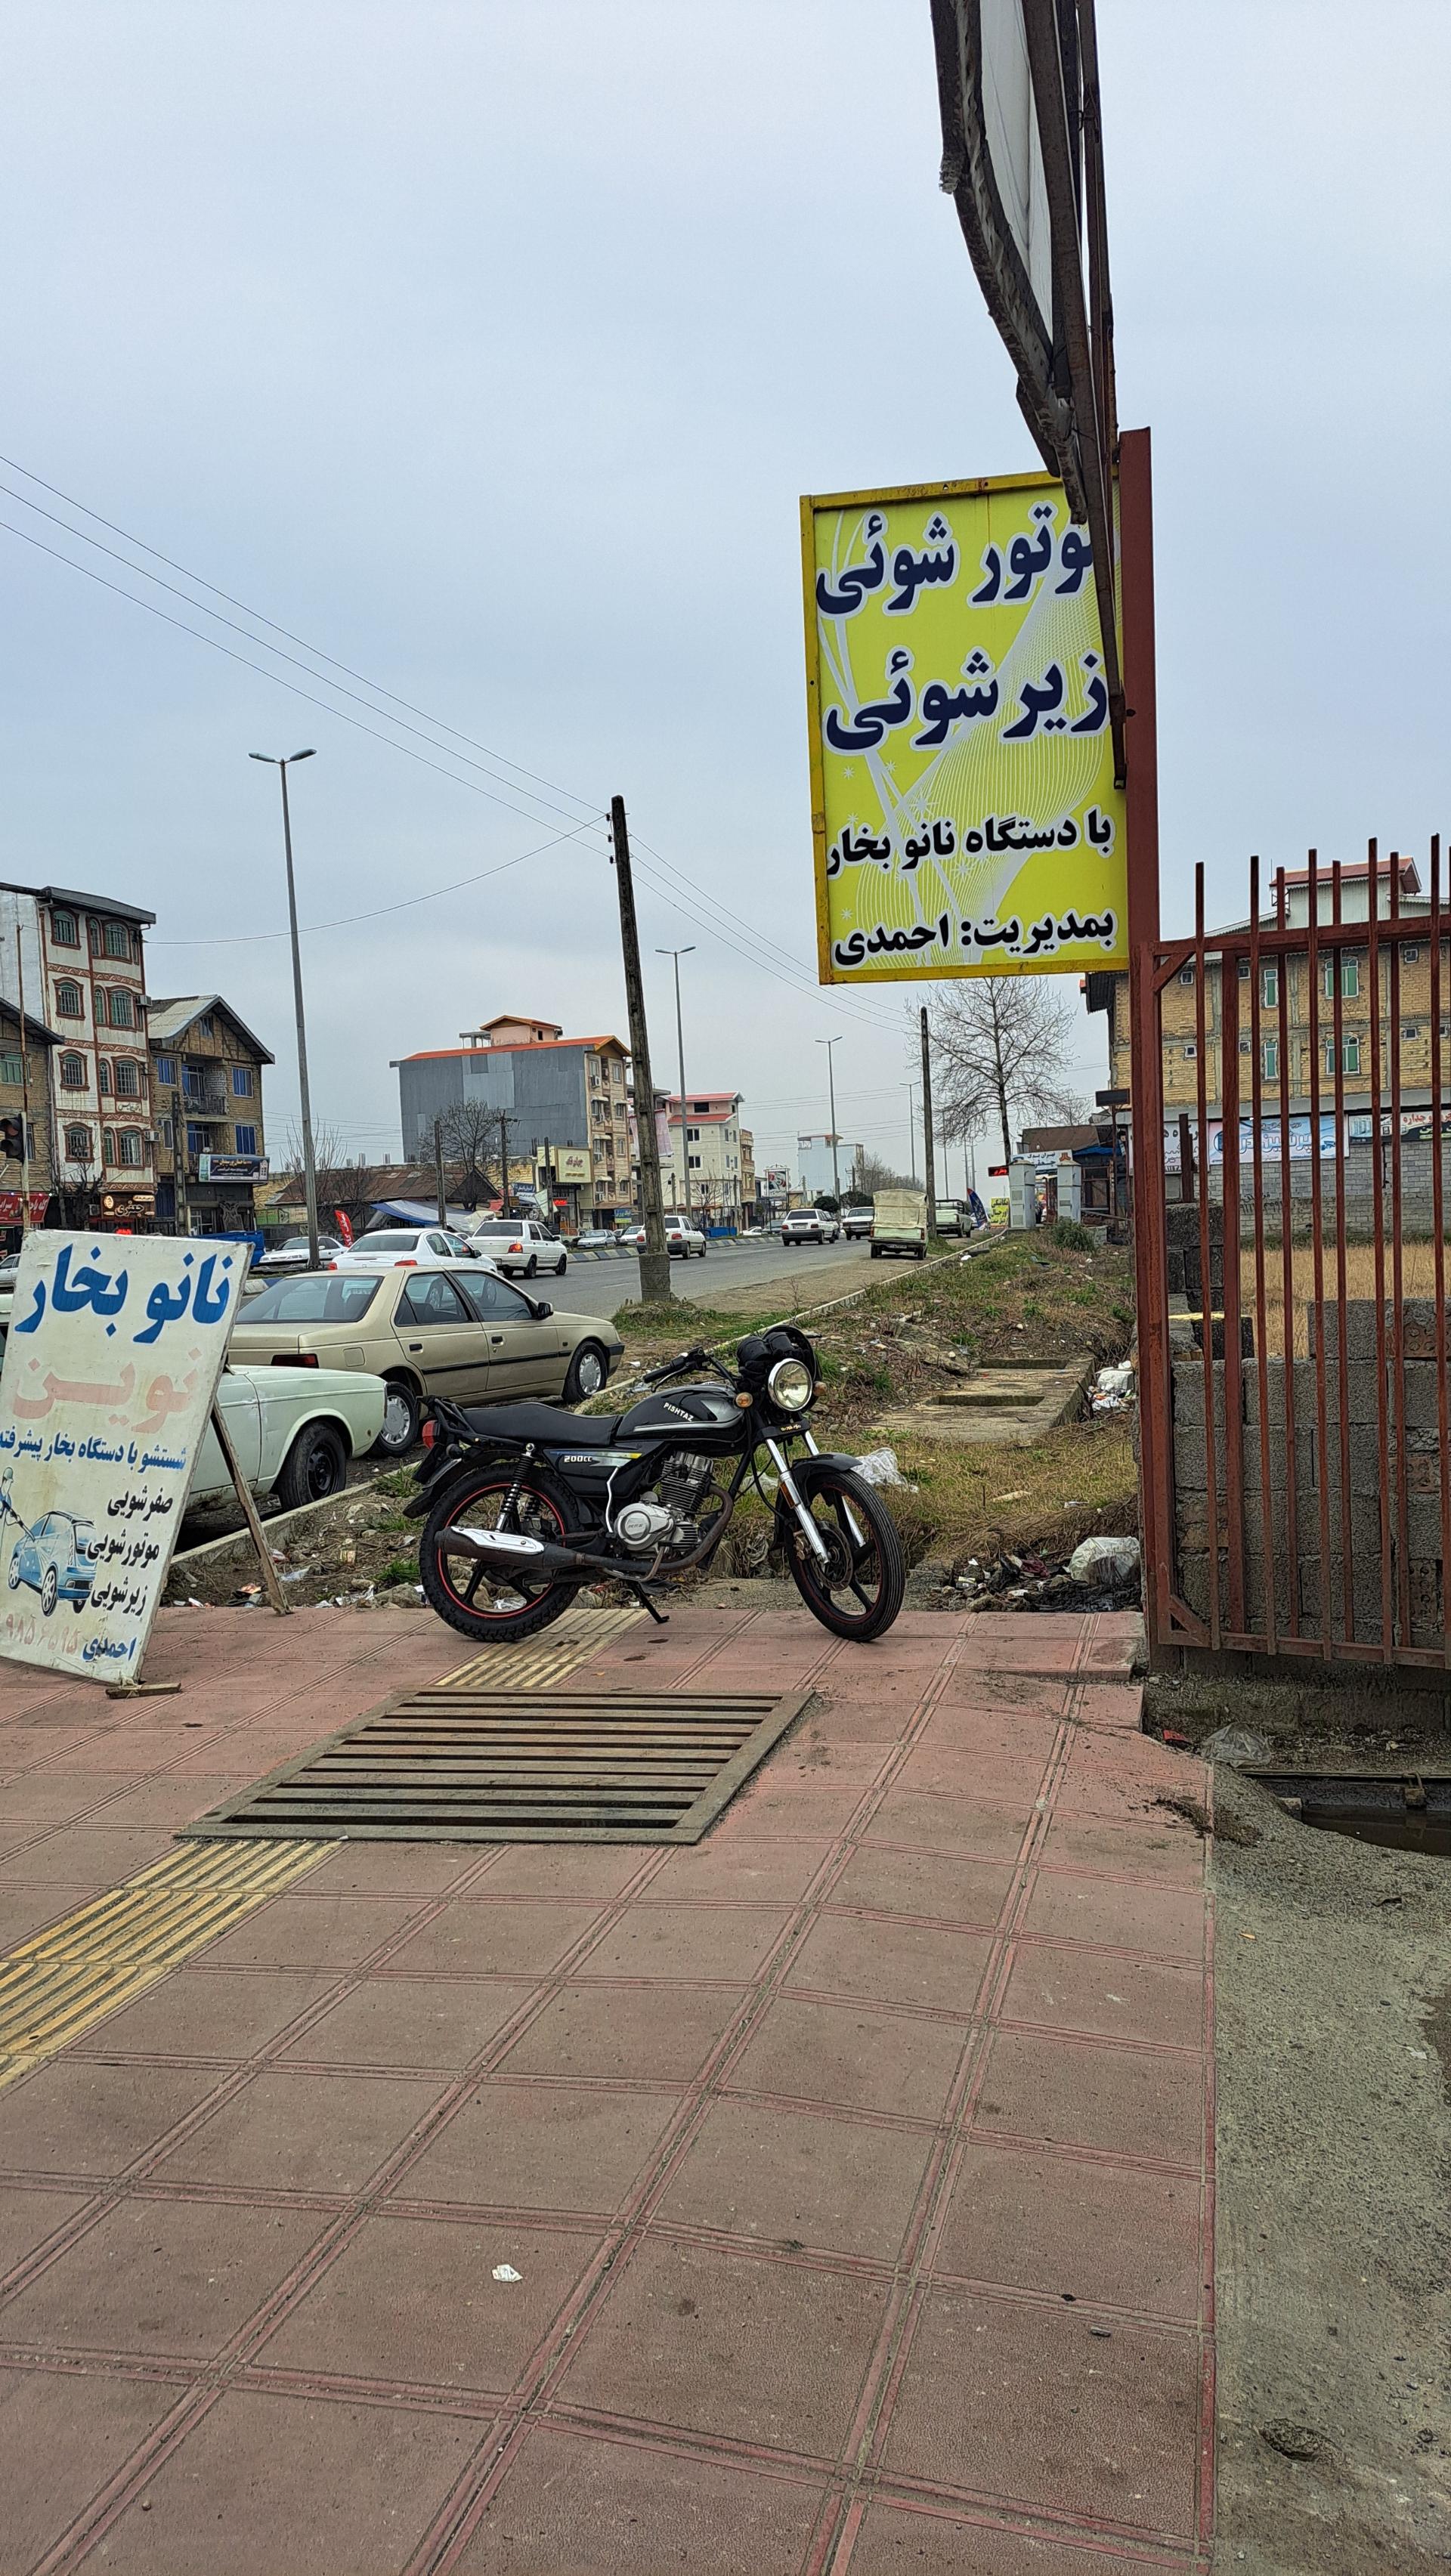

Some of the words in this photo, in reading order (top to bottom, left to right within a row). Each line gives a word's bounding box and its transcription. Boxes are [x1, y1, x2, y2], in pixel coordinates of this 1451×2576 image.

[817, 514, 954, 614] شوئی
[828, 826, 891, 875] بخار
[902, 821, 955, 870] نانو
[965, 815, 1076, 854] دستگاه
[1087, 809, 1112, 855] با
[835, 914, 949, 966] احمدی
[115, 1200, 145, 1217] جعفری
[14, 1244, 128, 1337] بخار
[132, 1252, 234, 1344] نانو
[11, 1349, 200, 1434] نوین
[663, 1402, 695, 1422] PISHTAZ
[44, 1432, 76, 1463] بخار
[78, 1436, 124, 1462] دستگاه
[127, 1441, 138, 1470] با
[138, 1444, 187, 1474] شستشو
[86, 1528, 159, 1569] موتورشویی
[91, 1576, 147, 1616] زیرشویی
[83, 1637, 138, 1661] احمدی
